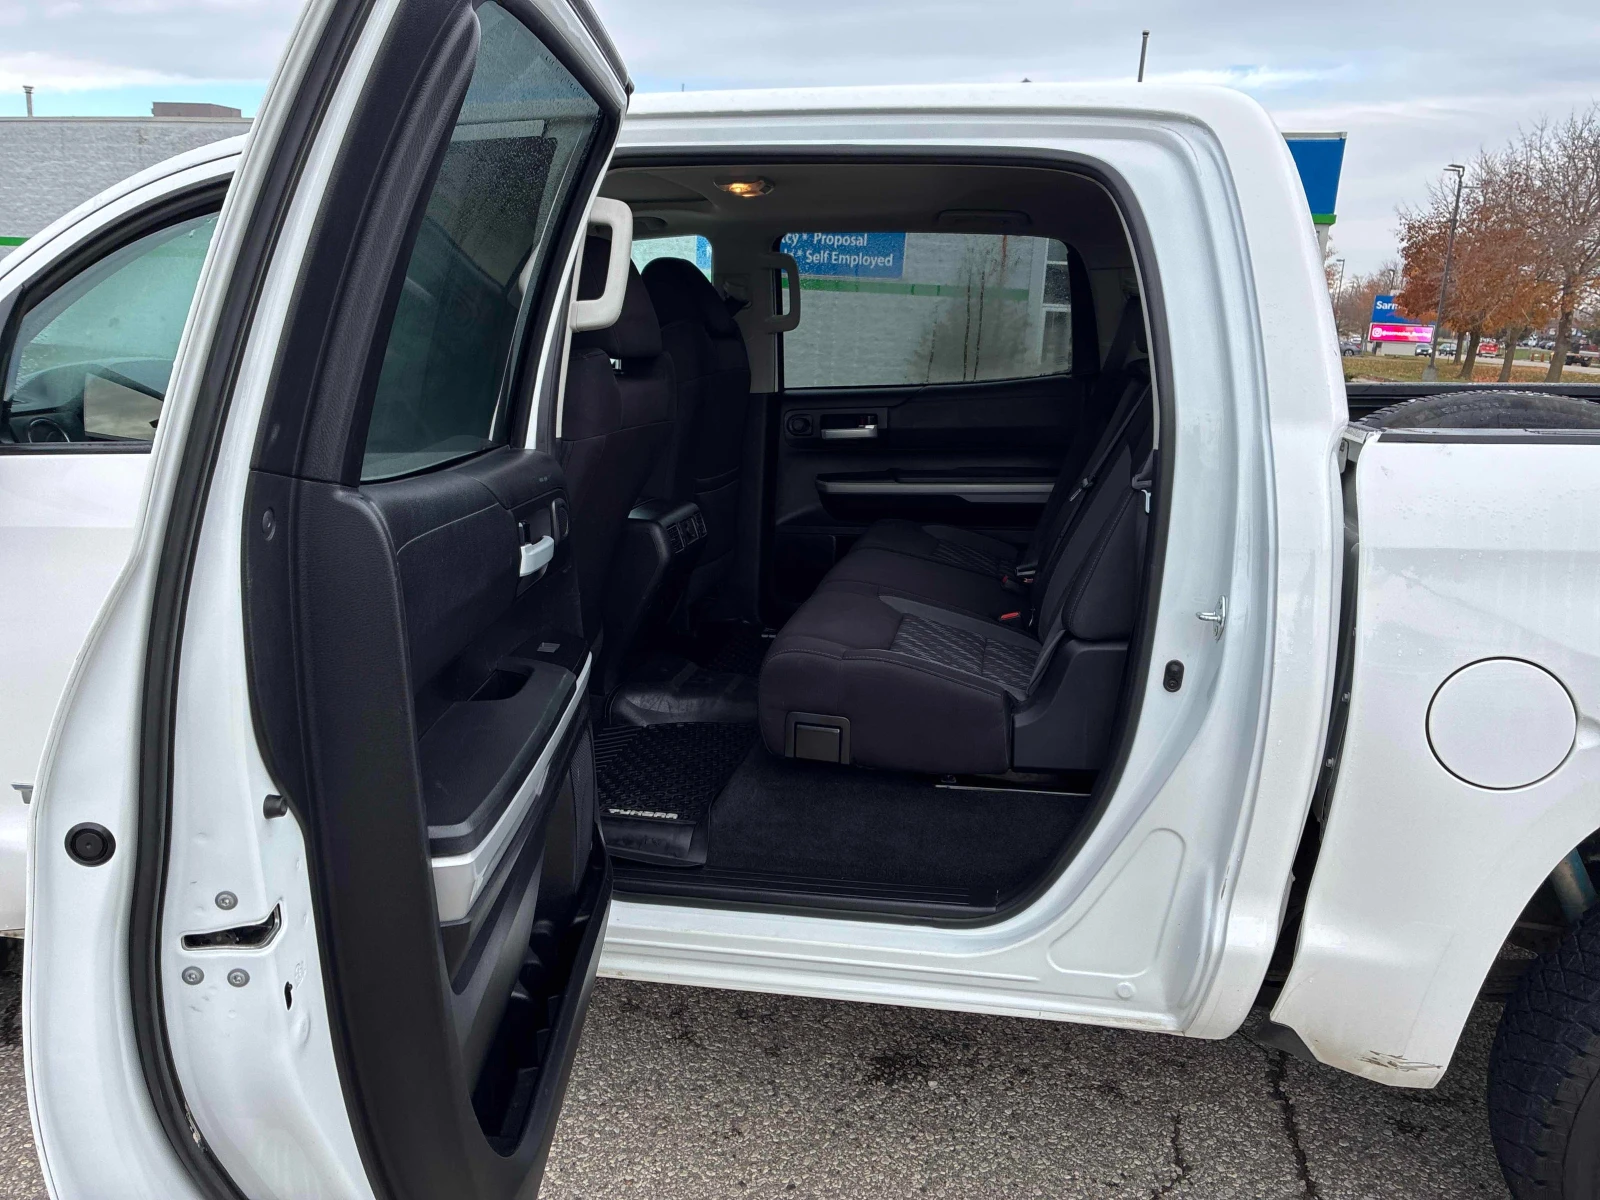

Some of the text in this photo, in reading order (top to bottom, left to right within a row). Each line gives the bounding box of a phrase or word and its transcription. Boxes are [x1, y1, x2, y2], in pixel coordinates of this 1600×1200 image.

[813, 233, 868, 248] Proposal
[805, 250, 829, 264] Self
[831, 251, 894, 269] Employed
[608, 808, 678, 819] TUNDRA
